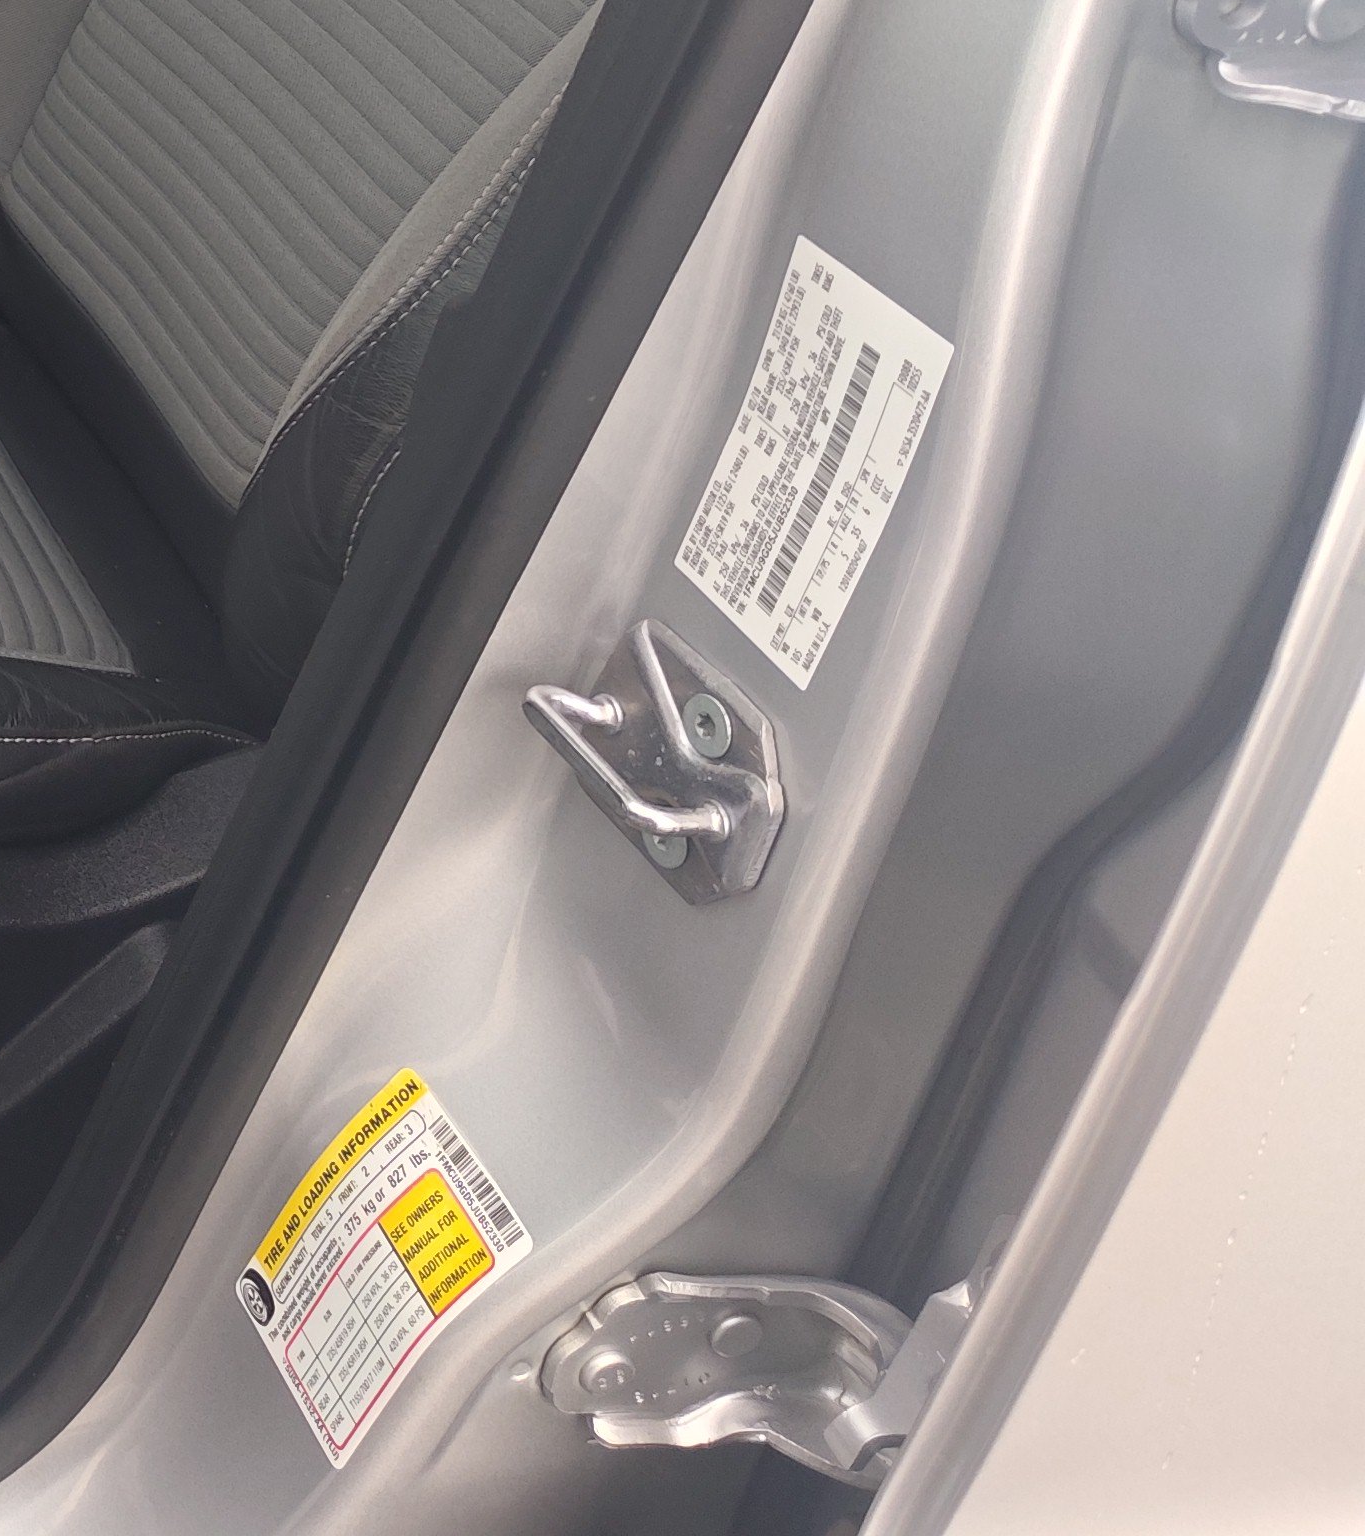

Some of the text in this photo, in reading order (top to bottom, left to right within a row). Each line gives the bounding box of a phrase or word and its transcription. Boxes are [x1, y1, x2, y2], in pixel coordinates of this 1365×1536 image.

[383, 1122, 414, 1154] REAR: 3
[262, 1077, 420, 1272] TIRE AND LOADING INFORMATION
[342, 1143, 432, 1237] 375 kg or 827 lbs.
[324, 1207, 334, 1221] 5
[388, 1186, 444, 1245] SEE OWNERS
[400, 1205, 458, 1266] MANUAL FOR
[415, 1227, 470, 1284] ADDITIONAL
[426, 1244, 488, 1308] INFORMATION
